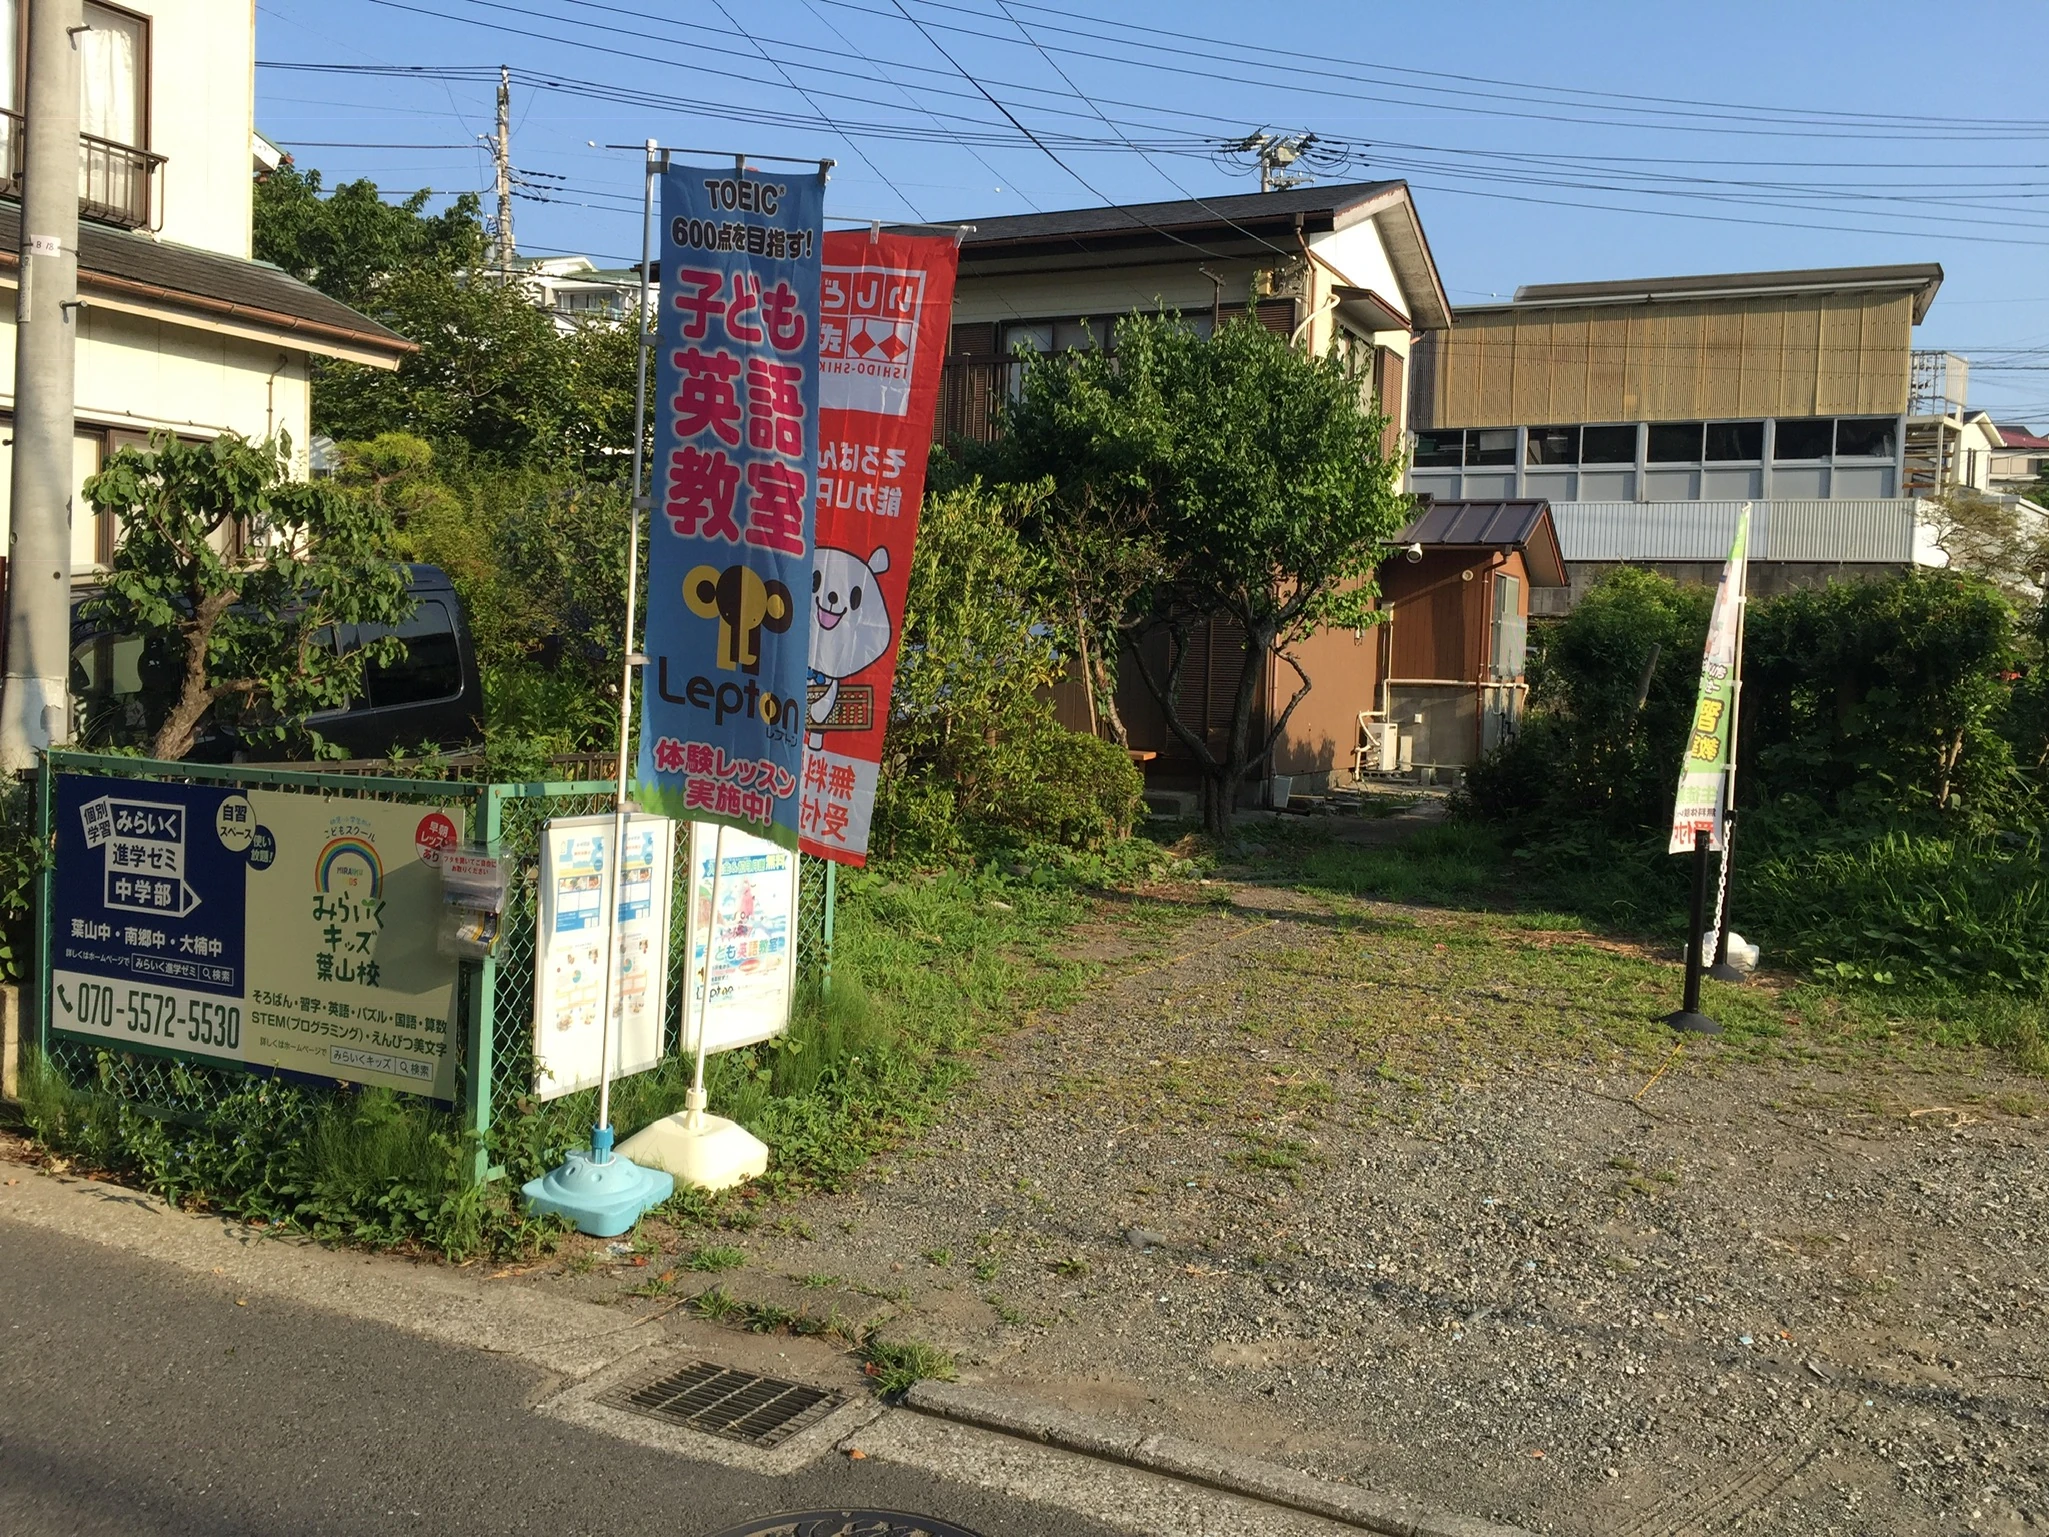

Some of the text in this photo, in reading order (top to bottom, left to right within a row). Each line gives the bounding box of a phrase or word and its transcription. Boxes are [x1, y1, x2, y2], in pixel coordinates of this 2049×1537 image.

[672, 217, 813, 259] 600点を目指す!
[674, 267, 806, 352] 子ども
[673, 347, 804, 458] 英語
[666, 445, 806, 557] 教室
[658, 656, 799, 735] Lepton
[765, 727, 798, 748] レプトン
[654, 738, 796, 797] 体験レッスン
[84, 800, 108, 824] 個別
[222, 804, 247, 823] 自習
[684, 779, 773, 826] 実施中!
[87, 822, 112, 844] 学習
[116, 810, 178, 839] みらいく
[219, 826, 253, 840] スペース
[324, 825, 376, 843] こどもスクール
[428, 821, 449, 838] 早朝
[253, 834, 272, 848] 使い
[421, 831, 452, 849] レッス
[112, 843, 177, 873] 進学ゼミ
[250, 849, 274, 864] 放題!
[422, 848, 440, 863] あり
[115, 877, 172, 907] 中学部
[312, 890, 387, 930] みらいく
[71, 918, 222, 958] 葉山中・南郷中・大楠中
[323, 924, 378, 955] キッズ
[65, 948, 131, 967] 詳しくはホームページで
[135, 957, 230, 983] みらいく進学ゼミ 検索
[316, 952, 381, 988] 葉山校
[77, 982, 240, 1050] 070-5572-5530
[252, 989, 448, 1035] そろばん・習字・英語・パズル・国語・算数
[333, 1049, 430, 1078] みらいくキッズ 検索
